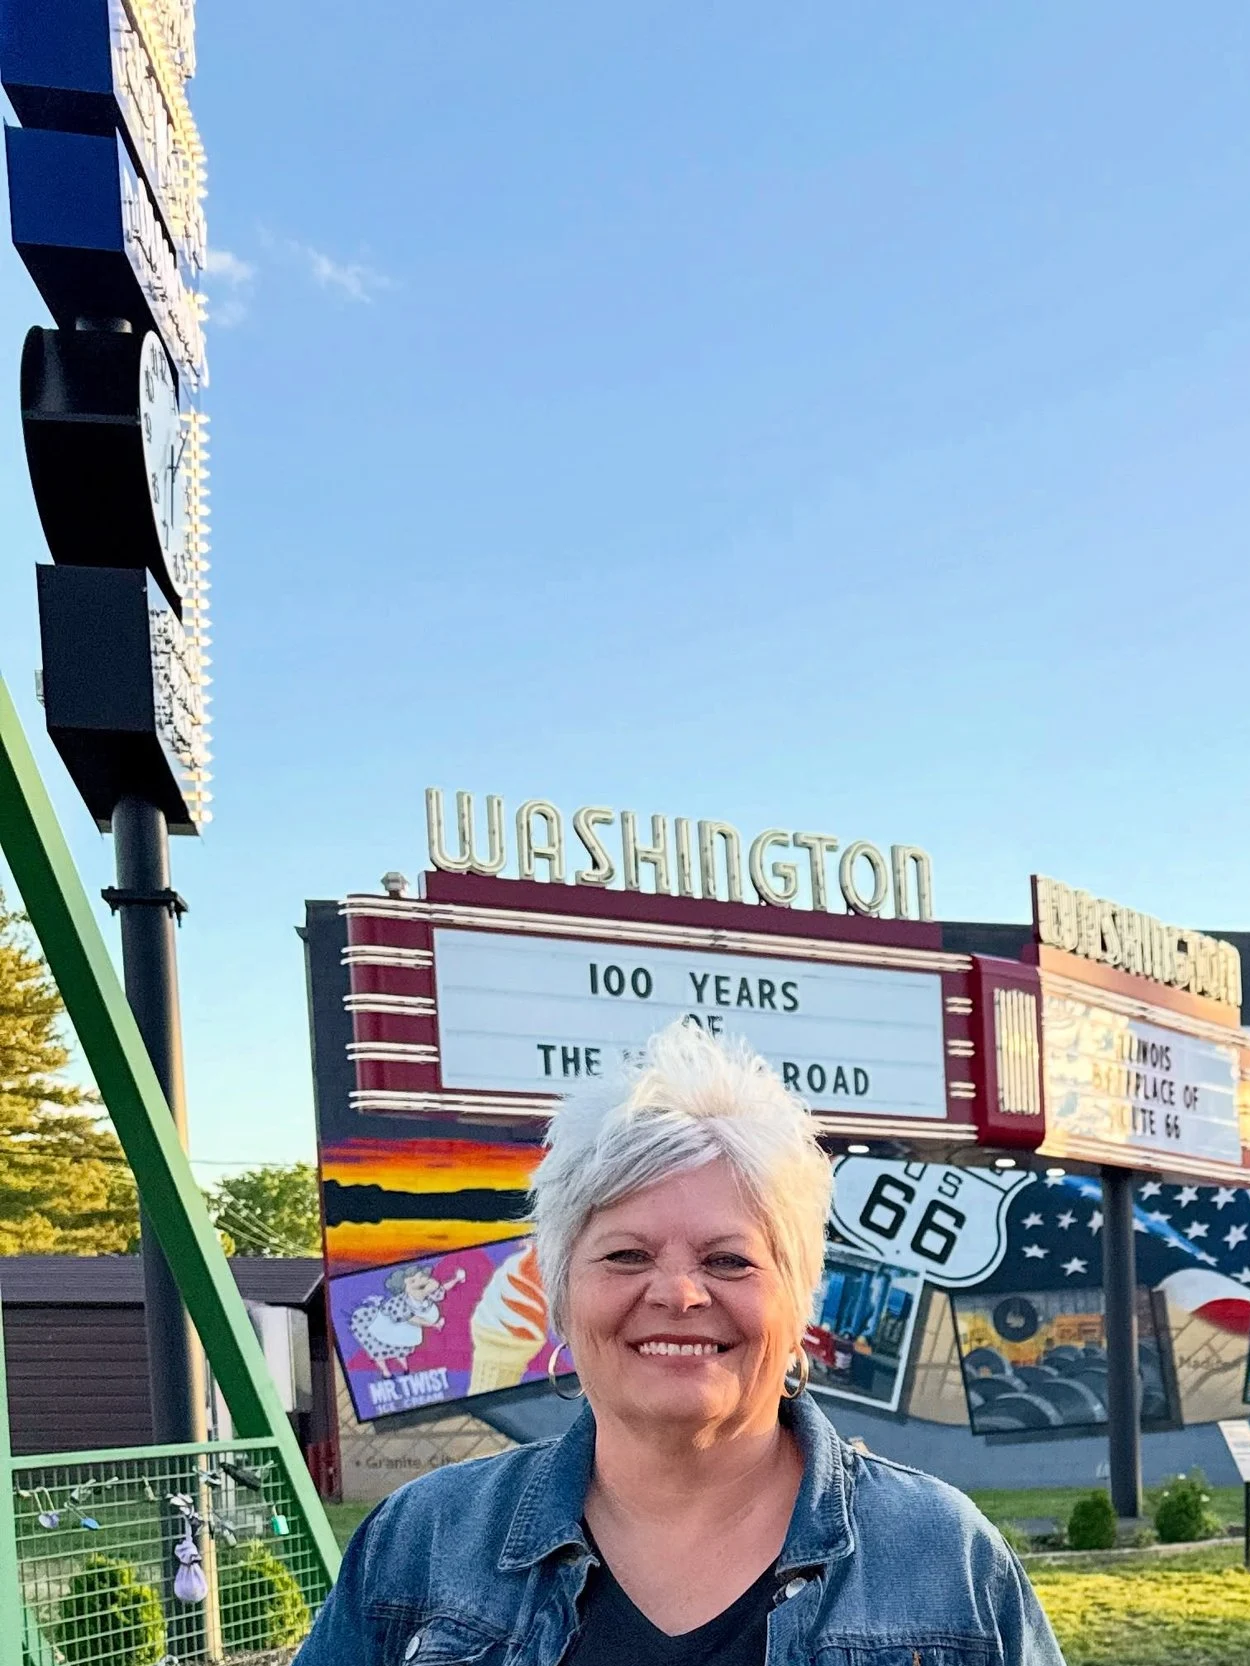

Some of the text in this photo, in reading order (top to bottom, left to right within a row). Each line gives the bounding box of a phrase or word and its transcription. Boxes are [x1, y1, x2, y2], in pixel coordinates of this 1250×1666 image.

[425, 787, 934, 922] WASHINGTON
[589, 962, 800, 1012] 100 YEARS
[537, 1044, 601, 1077] THE
[783, 1062, 869, 1096] ROAD
[1092, 1062, 1199, 1111] BPLACE OF
[1164, 1113, 1180, 1139] 66
[859, 1173, 966, 1265] 66
[395, 1367, 449, 1397] TWIST
[366, 1453, 454, 1469] Granite Cit
